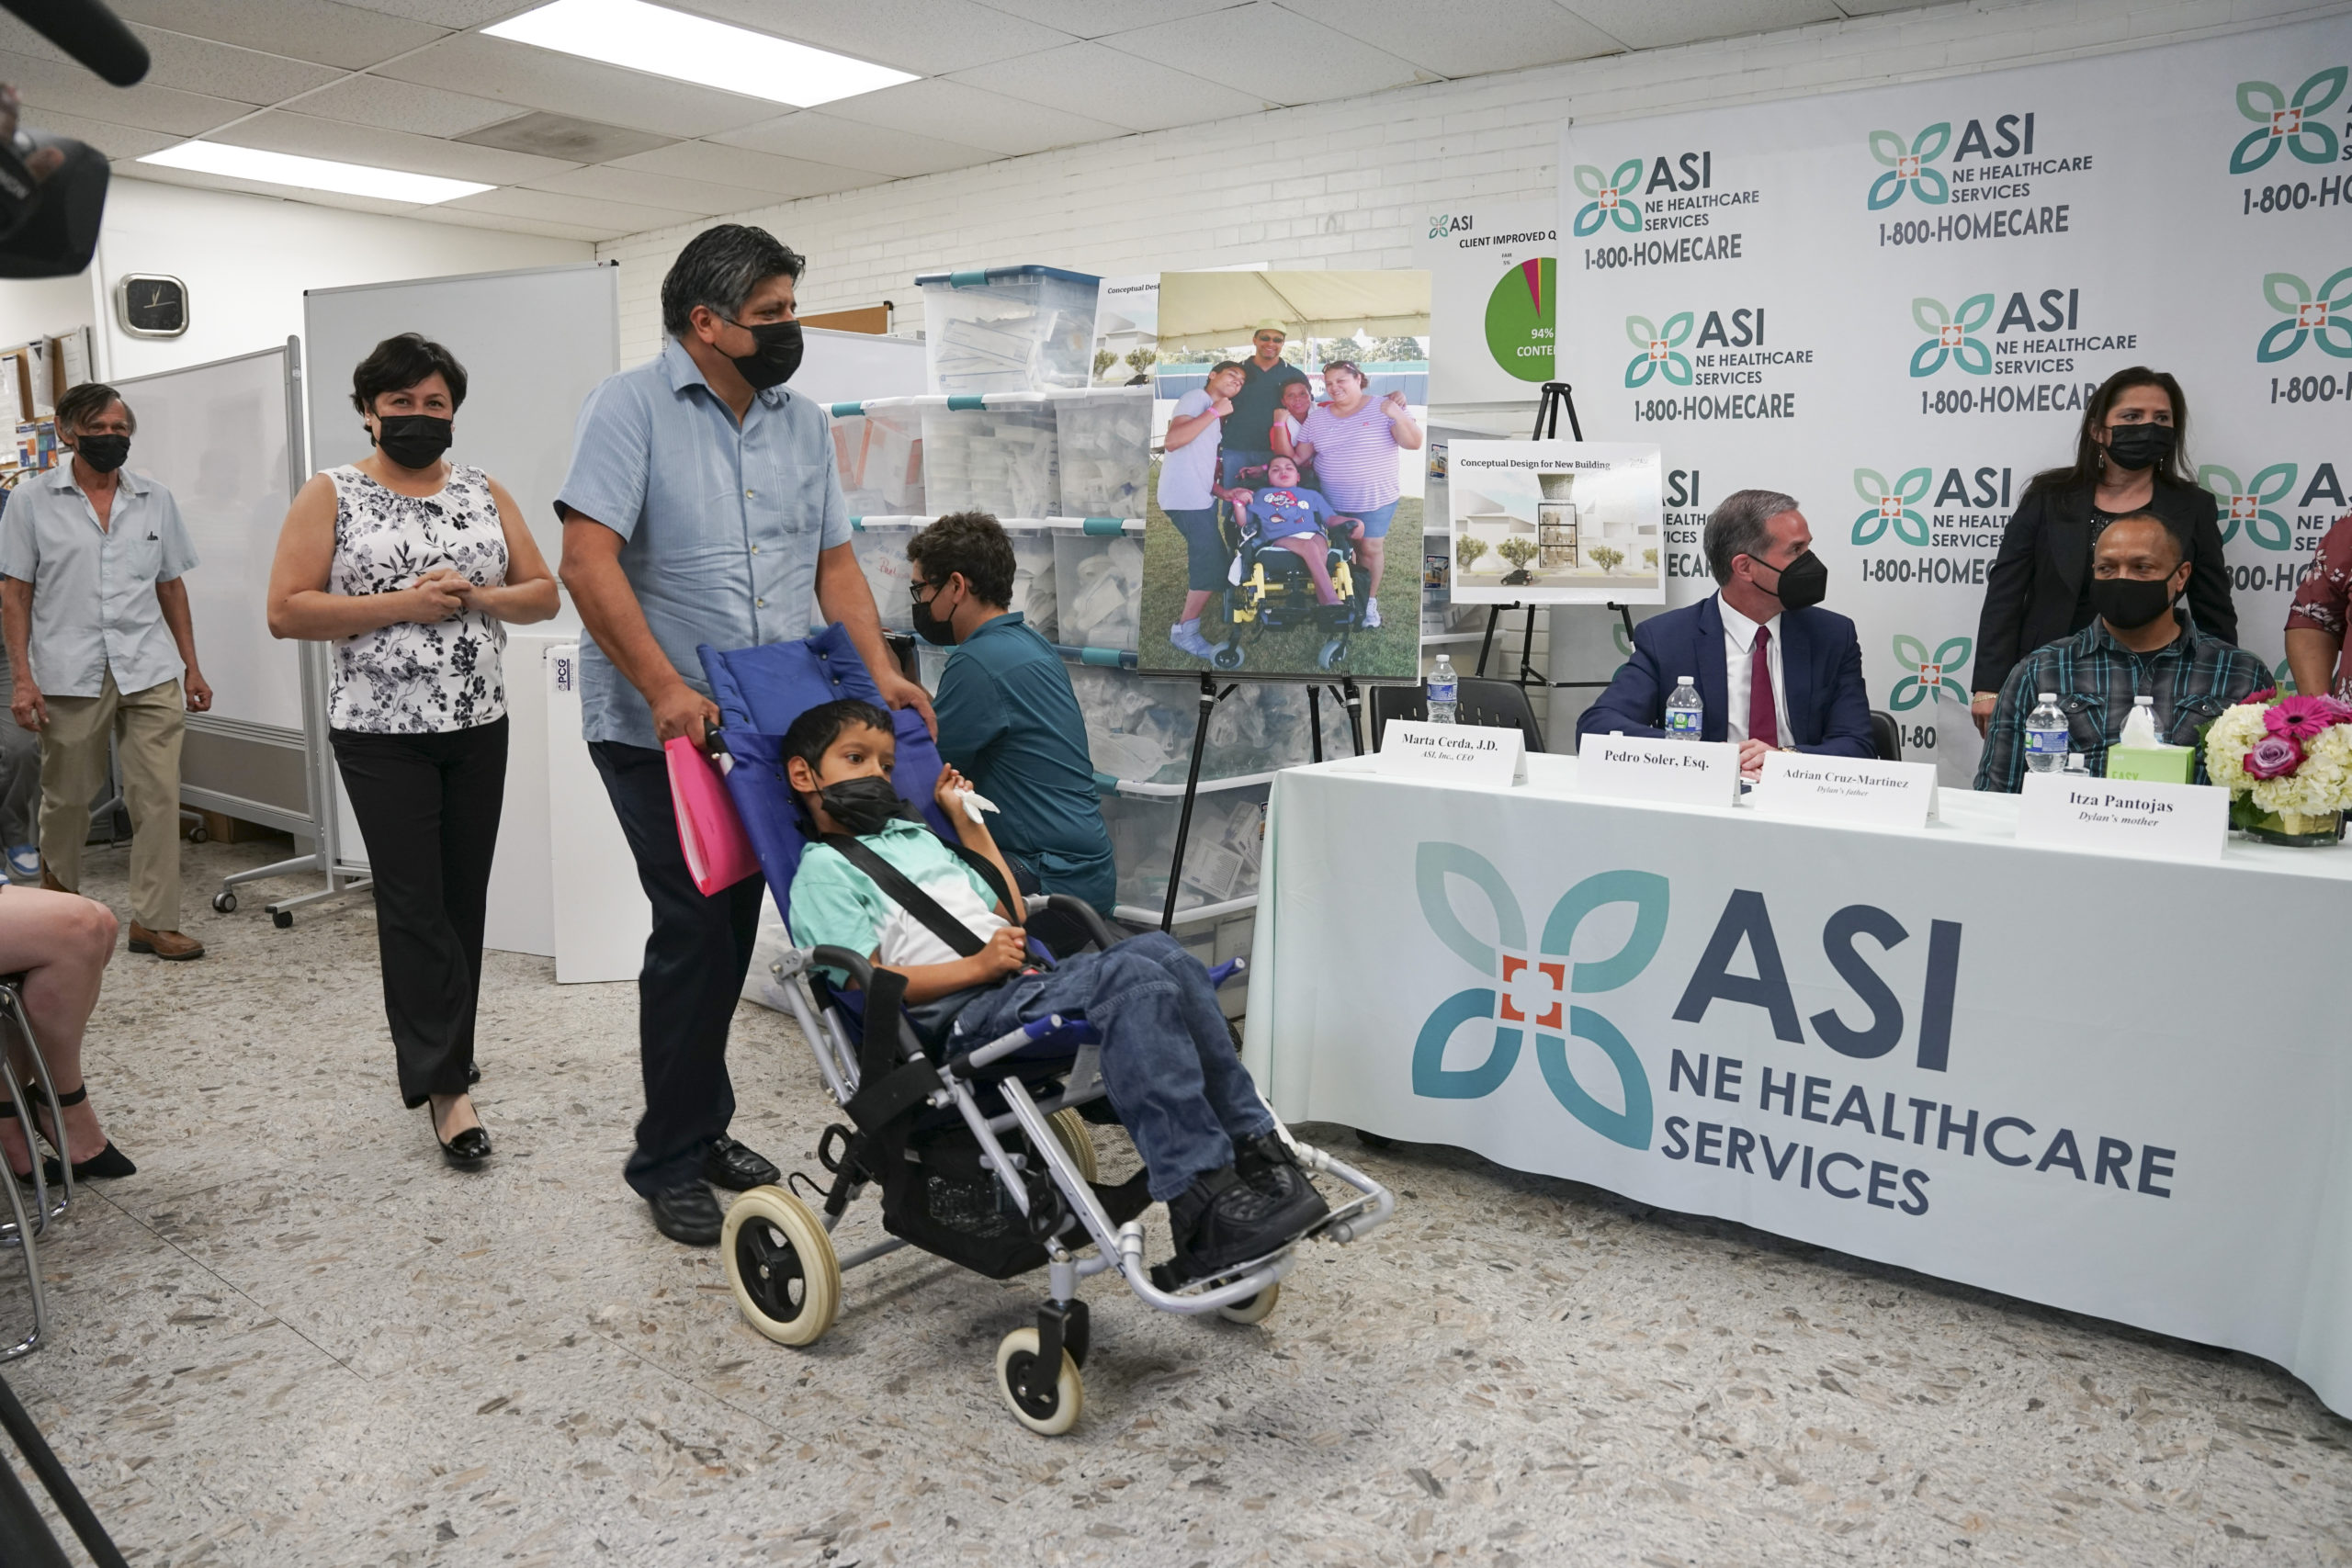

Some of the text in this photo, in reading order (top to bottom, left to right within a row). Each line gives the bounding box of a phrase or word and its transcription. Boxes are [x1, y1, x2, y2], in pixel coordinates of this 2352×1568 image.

[1952, 111, 2035, 163] ASI
[1645, 151, 1712, 195] ASI
[1952, 154, 2093, 184] NE HEALTHCARE
[1645, 190, 1759, 214] NE HEALTHCARE
[1951, 182, 2030, 204] SERVICES
[1449, 214, 1474, 232] ASI
[1644, 212, 1710, 232] SERVICES
[1880, 204, 2070, 247] 1-800-HOMECARE
[1459, 236, 1491, 249] CLIENT
[1492, 231, 1546, 246] IMPROVED
[1585, 232, 1742, 270] 1-800-HOMECARE
[1107, 284, 1145, 294] Conceptual
[1996, 288, 2079, 334] ASI
[1531, 327, 1555, 340] 94%
[1696, 308, 1765, 349] ASI
[1996, 334, 2137, 355] NE HEALTHCARE
[1695, 350, 1814, 368] NE HEALTHCARE
[1994, 357, 2075, 376] SERVICES
[1695, 370, 1763, 386] SERVICES
[1634, 392, 1795, 423] 1-800-HOMECARE
[1460, 458, 1611, 470] Conceptual Design for New Building
[1933, 467, 2012, 509] ASI
[1933, 514, 1954, 528] NE
[2297, 514, 2324, 530] NE
[1402, 733, 1498, 751] Marta Cerda, J.D.
[1456, 753, 1475, 761] CEO
[1604, 749, 1710, 771] Pedro Soler, Esq.
[1782, 768, 1909, 789] Adrian Cruz-Martinez
[1845, 789, 1870, 797] father
[2069, 792, 2174, 814] Itza Pantojas
[2078, 811, 2159, 827] Dylan's mother
[1669, 887, 1963, 1073] ASI
[1668, 1048, 2177, 1199] NE HEALTHCARE
[1661, 1115, 1931, 1216] SERVICES
